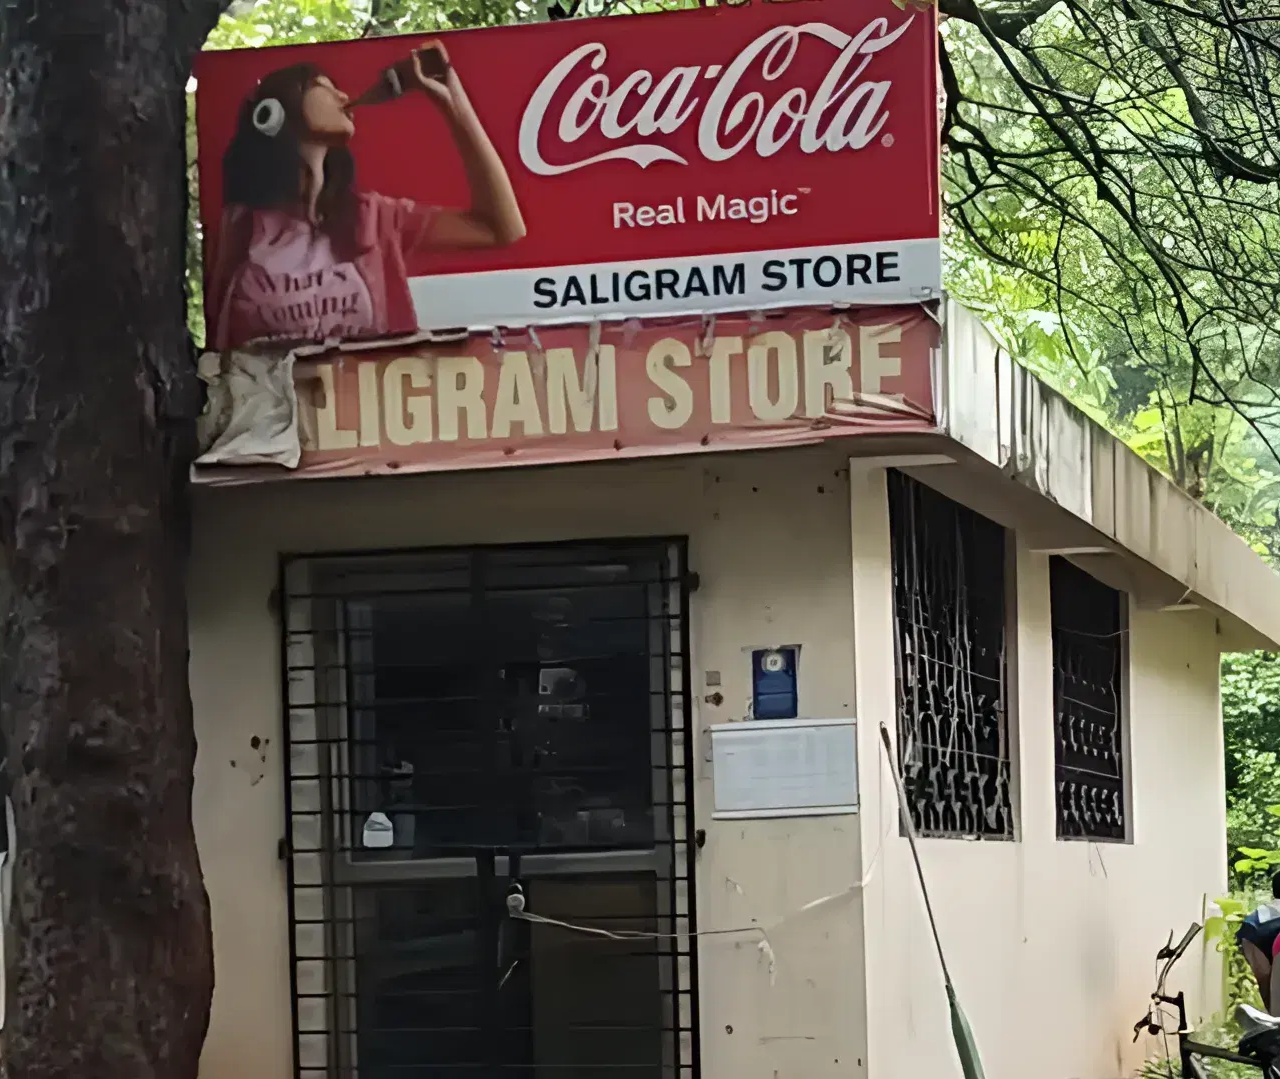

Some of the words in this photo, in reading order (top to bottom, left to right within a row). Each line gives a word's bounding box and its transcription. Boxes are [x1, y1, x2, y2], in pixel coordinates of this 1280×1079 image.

[519, 14, 916, 176] Coca-Cola
[613, 197, 685, 229] Real
[533, 262, 746, 309] SALIGRAM
[761, 251, 901, 292] STORE
[304, 344, 619, 452] LIGRAM
[645, 324, 906, 430] STORE
